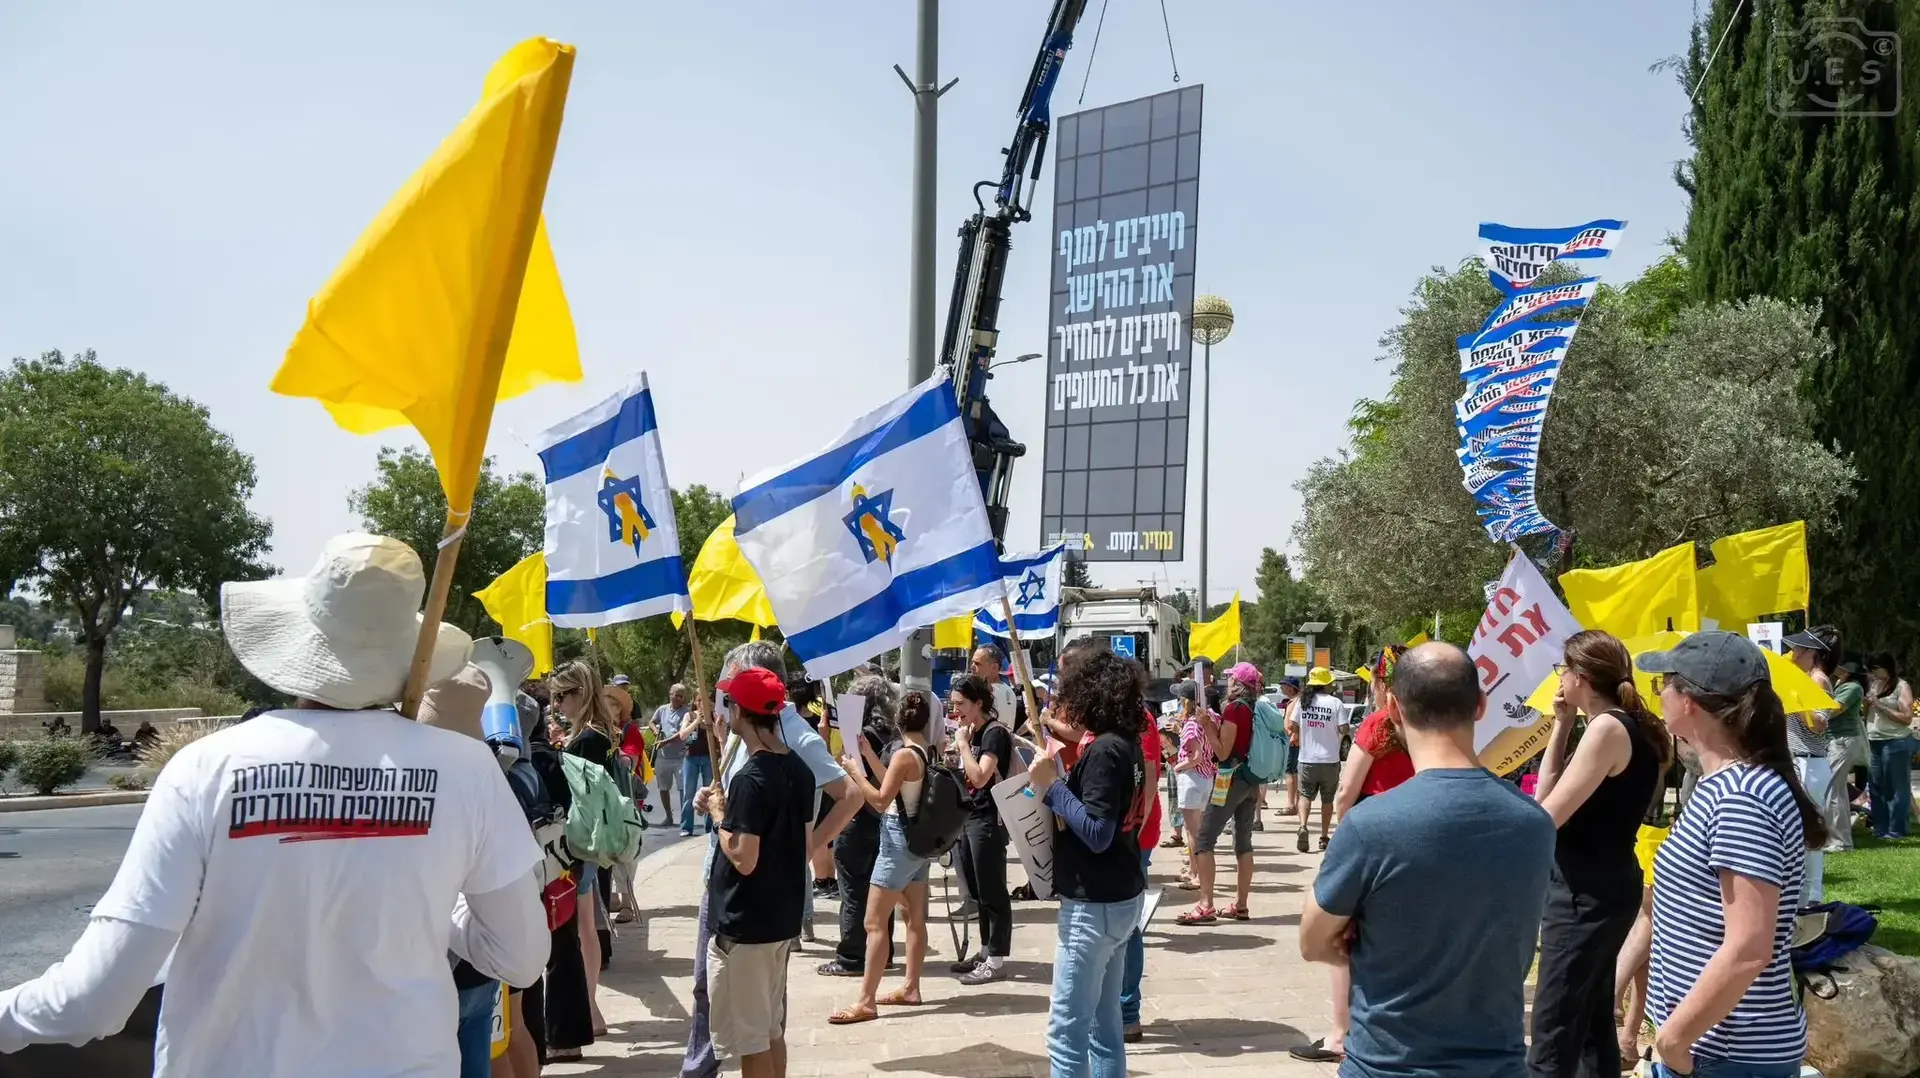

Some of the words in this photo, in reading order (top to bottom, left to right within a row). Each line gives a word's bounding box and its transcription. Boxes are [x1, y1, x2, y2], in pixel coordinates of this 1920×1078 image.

[1060, 219, 1110, 273] למנף
[1114, 211, 1185, 259] חייבים
[1065, 267, 1135, 314] ההישג
[1140, 262, 1175, 305] את
[1056, 315, 1117, 363] להחזיר
[1120, 311, 1182, 356] חייבים
[1054, 367, 1124, 411] החטופים
[1129, 361, 1149, 404] כל
[1152, 362, 1180, 403] את
[1106, 531, 1138, 553] נקום.
[1139, 530, 1173, 551] נחזיר.
[1497, 602, 1552, 658] את
[1302, 712, 1318, 720] כולם
[1304, 705, 1332, 714] מחזירי
[1537, 721, 1551, 736] עוז
[1513, 735, 1538, 758] מחכה
[231, 760, 305, 793] להחזרת
[309, 762, 397, 792] המשפחות
[401, 768, 438, 793] מטה
[230, 792, 335, 831] והנעדרים
[341, 794, 436, 829] החטופים
